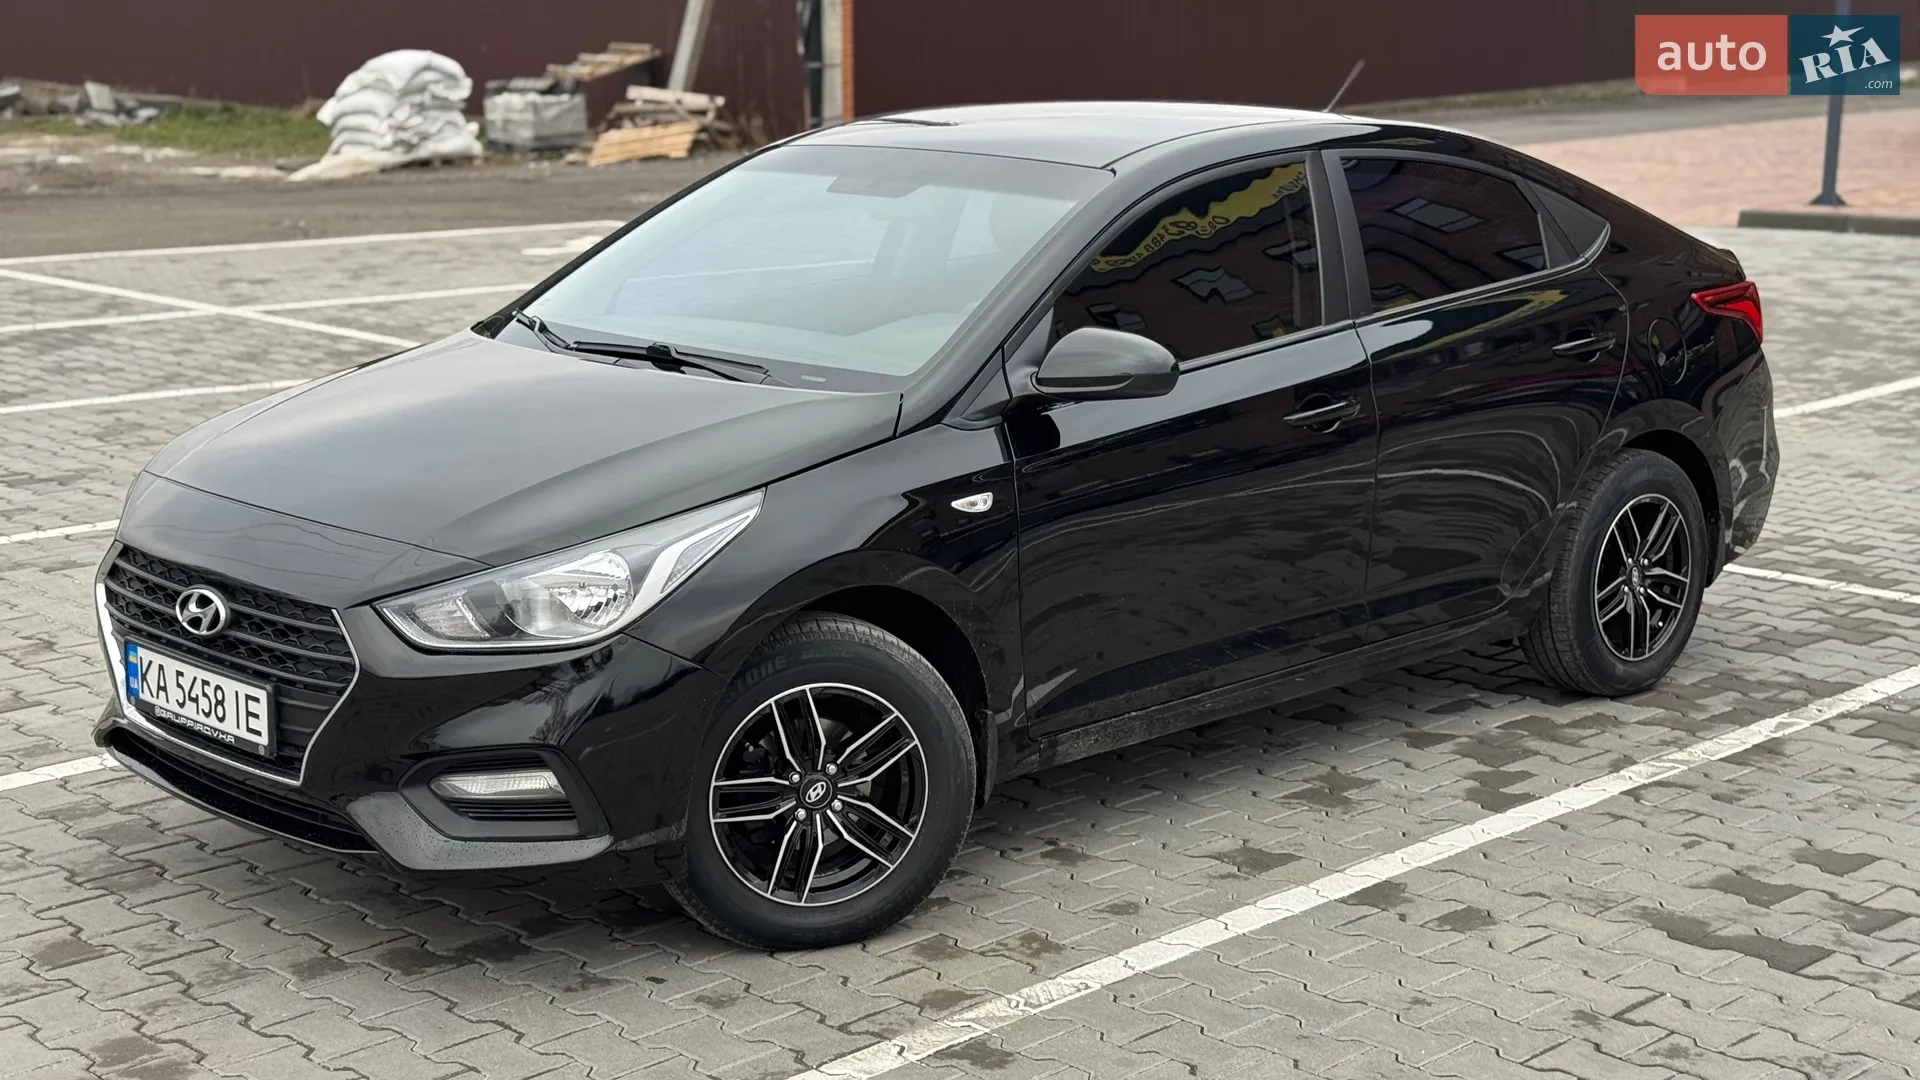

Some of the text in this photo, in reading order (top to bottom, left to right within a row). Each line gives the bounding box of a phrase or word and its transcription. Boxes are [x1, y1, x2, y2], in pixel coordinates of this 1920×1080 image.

[139, 656, 262, 738] KA 5458 IE
